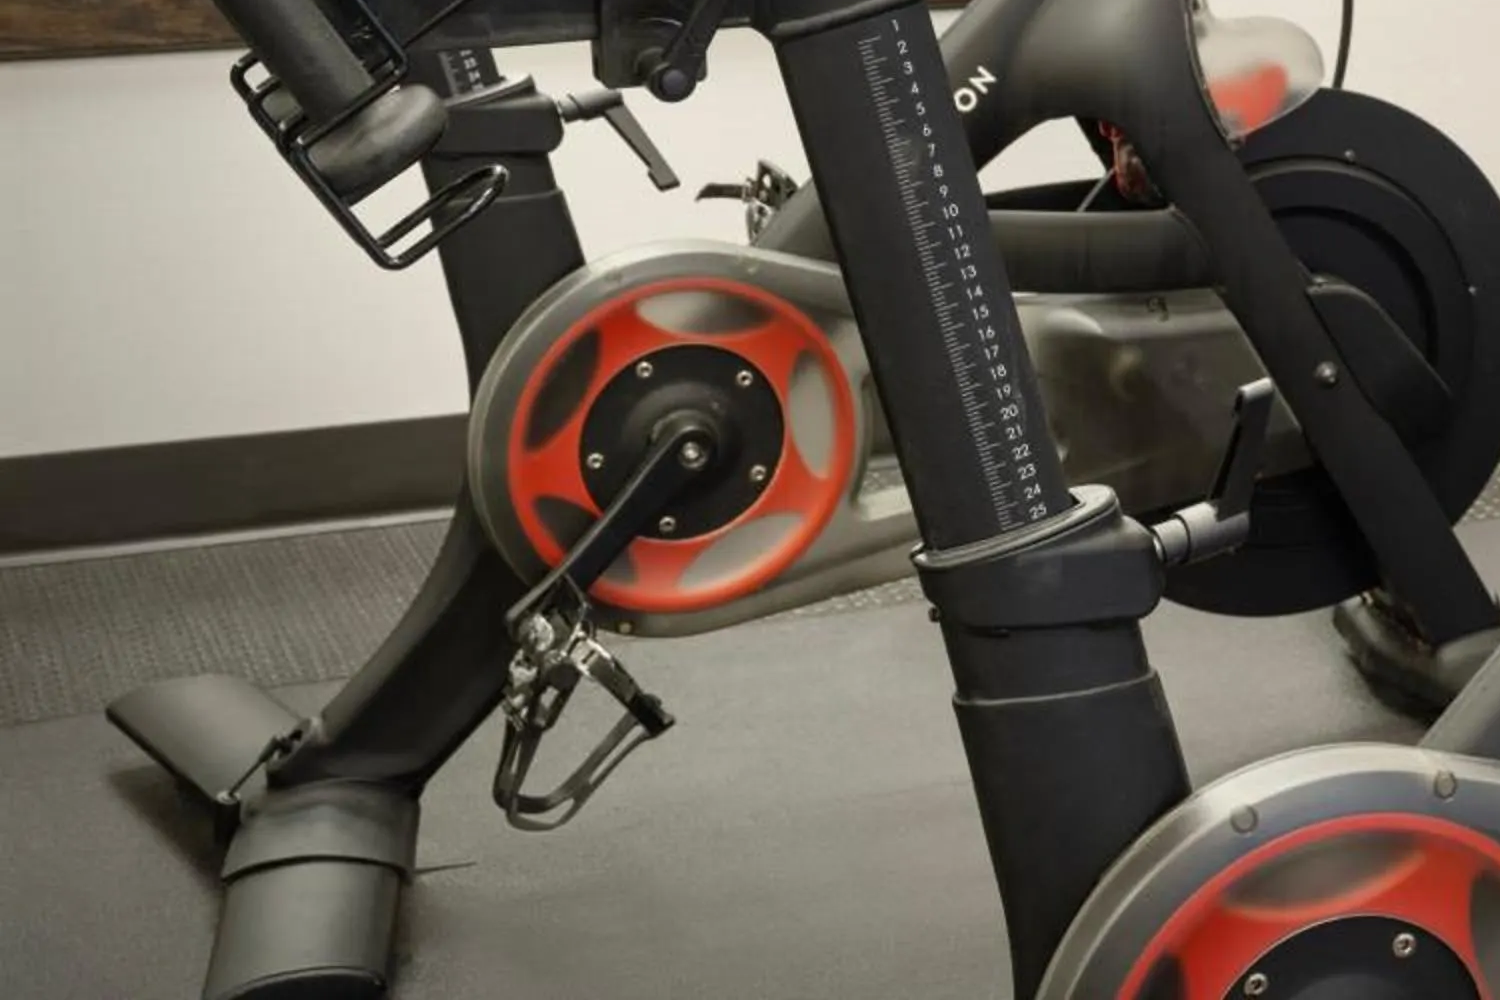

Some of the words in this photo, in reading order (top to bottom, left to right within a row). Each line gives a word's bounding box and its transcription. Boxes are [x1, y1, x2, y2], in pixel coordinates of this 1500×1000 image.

[892, 20, 899, 32] 1
[897, 39, 908, 54] 2
[903, 61, 914, 75] 3
[911, 81, 919, 94] 4
[916, 101, 926, 116] 5
[923, 123, 932, 137] 6
[927, 143, 936, 157] 7
[933, 164, 943, 178] 8
[939, 184, 948, 198] 9
[942, 204, 959, 220] 10
[947, 225, 963, 240] 11
[954, 244, 971, 260] 12
[960, 264, 977, 280] 13
[966, 284, 984, 301] 14
[972, 304, 989, 320] 15
[978, 325, 995, 341] 16
[984, 345, 999, 361] 17
[989, 364, 1007, 380] 18
[995, 384, 1011, 400] 19
[1000, 404, 1019, 420] 20
[1005, 424, 1023, 440] 21
[1012, 443, 1031, 460] 22
[1018, 463, 1036, 480] 23
[1024, 482, 1042, 500] 24
[1030, 502, 1047, 520] 25
